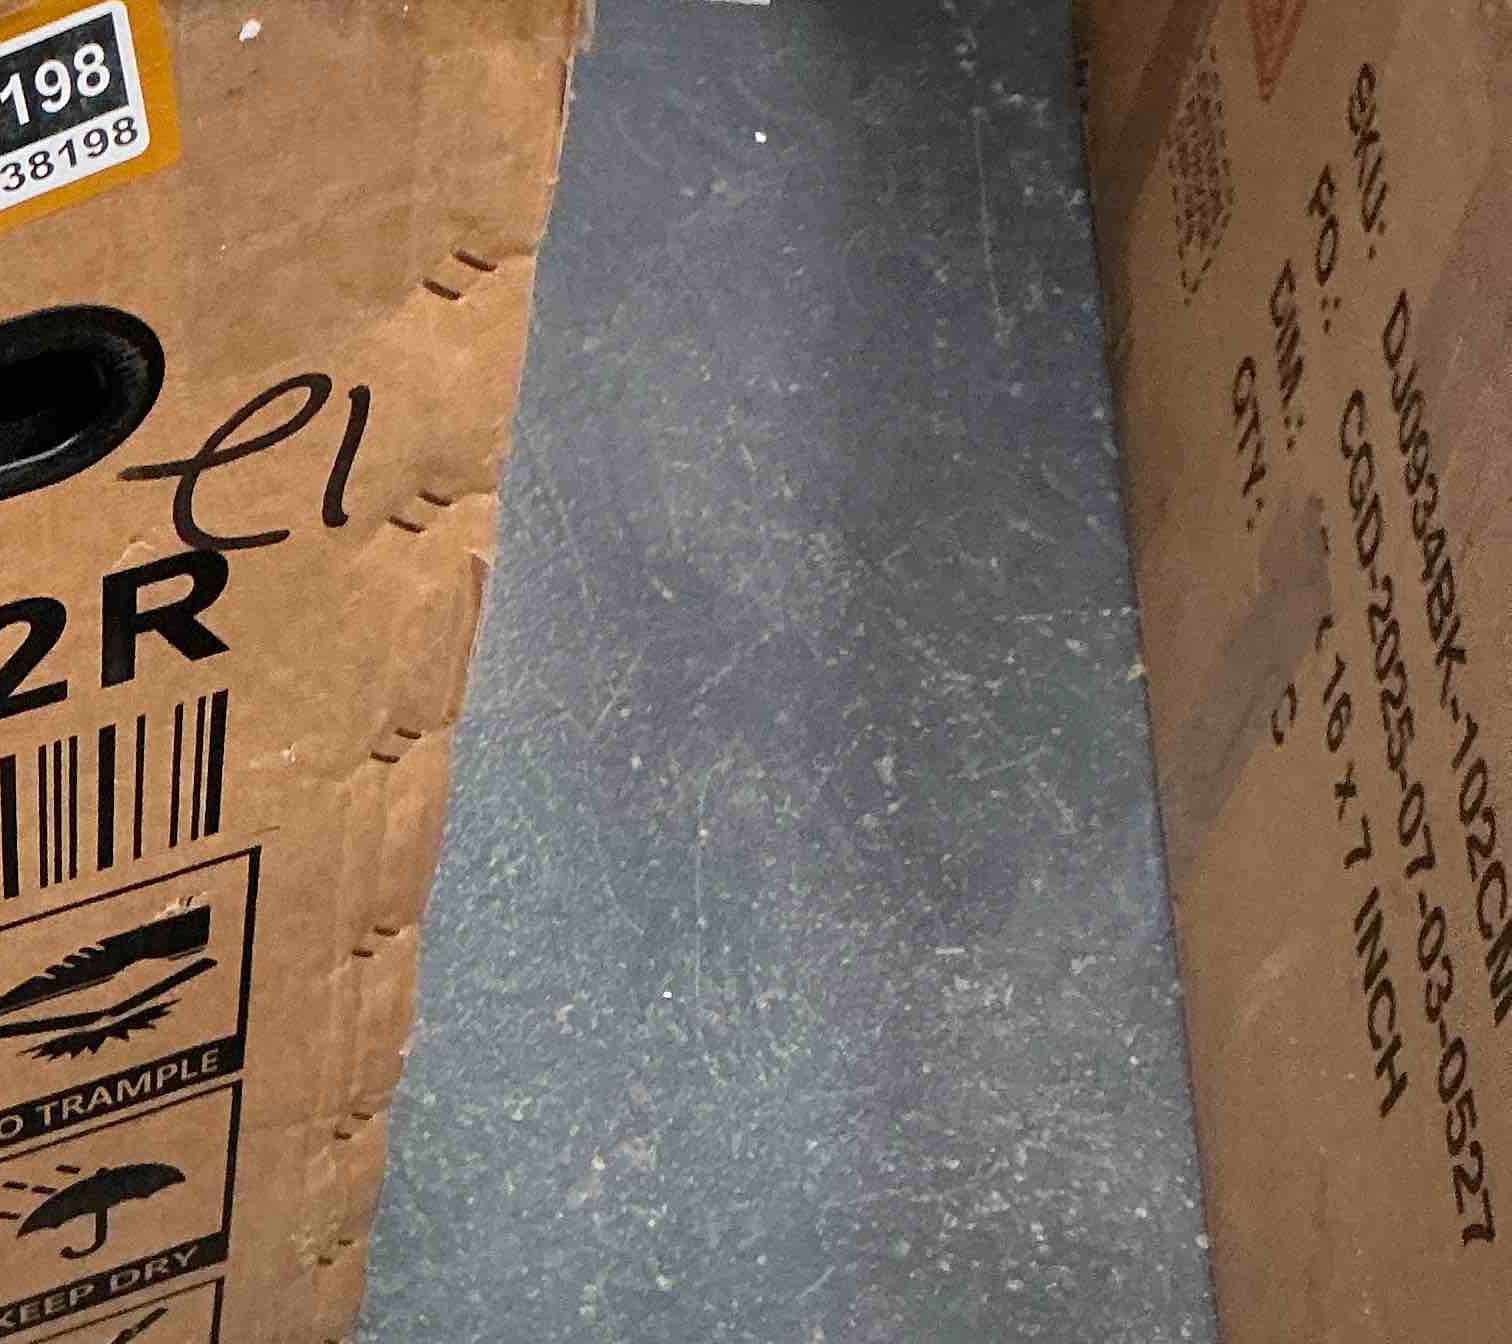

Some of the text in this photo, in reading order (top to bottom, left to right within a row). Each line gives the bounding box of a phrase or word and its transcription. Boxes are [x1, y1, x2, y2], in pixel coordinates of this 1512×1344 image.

[1346, 62, 1388, 262] SKU:
[1232, 356, 1267, 534] QTY:
[1323, 651, 1352, 753] 16
[1342, 814, 1372, 870] 7
[1353, 886, 1409, 1119] INCH
[36, 1049, 221, 1116] TRAMPLE
[109, 1244, 201, 1295] DRY
